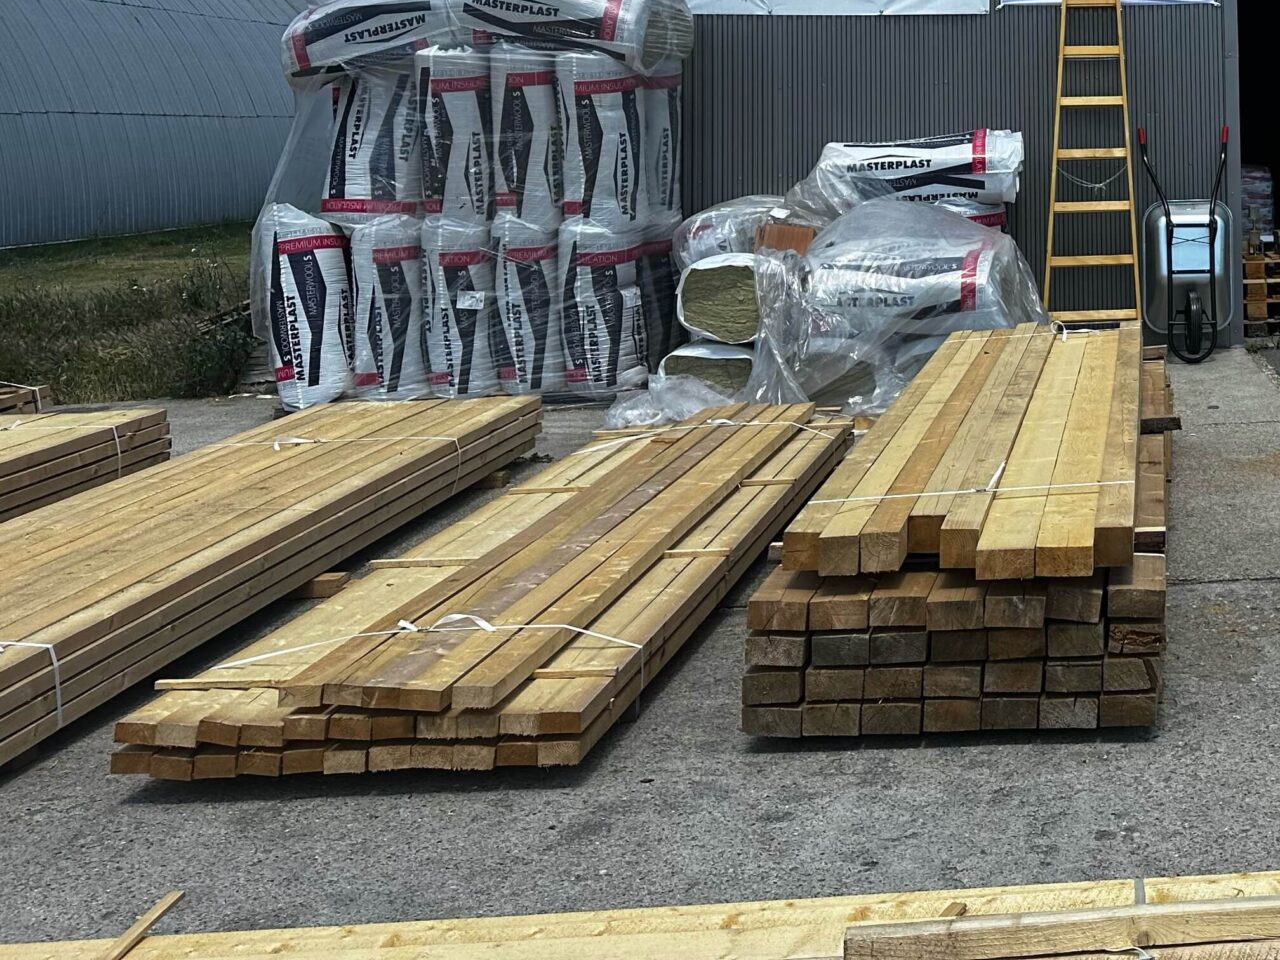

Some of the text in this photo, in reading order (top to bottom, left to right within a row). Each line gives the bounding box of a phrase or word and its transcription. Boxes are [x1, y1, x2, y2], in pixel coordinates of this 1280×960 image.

[344, 13, 426, 43] MASTERPLAST
[472, 131, 485, 215] MASTERPLAST
[582, 108, 594, 160] MASTERWOOL
[618, 132, 629, 215] MASTERPLAST
[846, 159, 932, 173] MASTERPLAST
[275, 300, 289, 355] MASTERWOOL
[303, 261, 318, 315] MASTERWOOL
[286, 295, 306, 381] MASTERPLAST
[441, 307, 455, 387] MASTERPLAST
[511, 303, 528, 383] MASTERPLAST
[585, 304, 603, 383] MASTERPLAST
